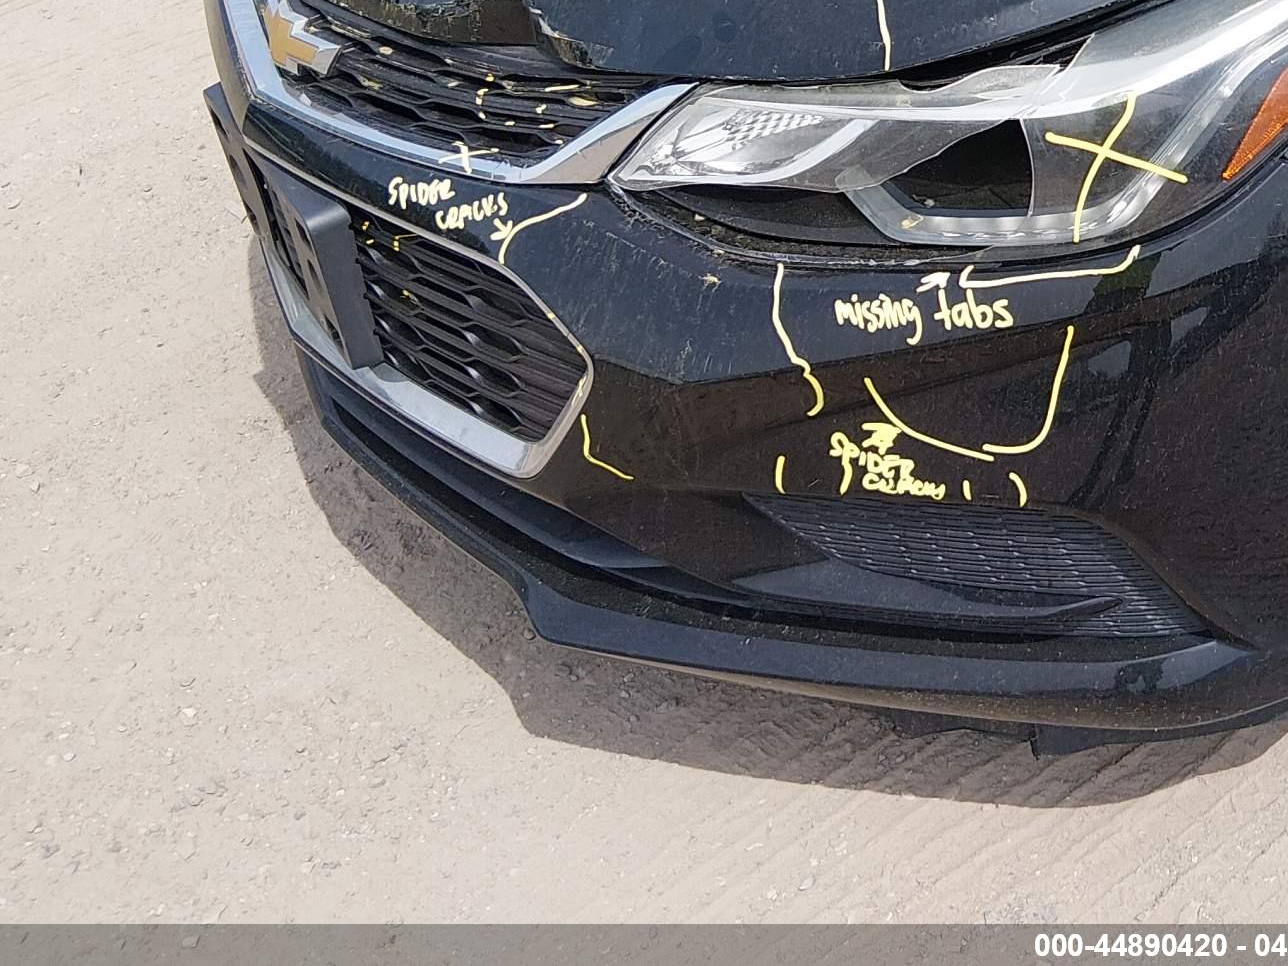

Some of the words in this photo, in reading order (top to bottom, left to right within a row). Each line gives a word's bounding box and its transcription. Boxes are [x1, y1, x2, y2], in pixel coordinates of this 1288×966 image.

[387, 176, 456, 210] SPIDER
[434, 192, 509, 231] CRACKS
[834, 293, 923, 345] missing
[933, 288, 1015, 330] tabs
